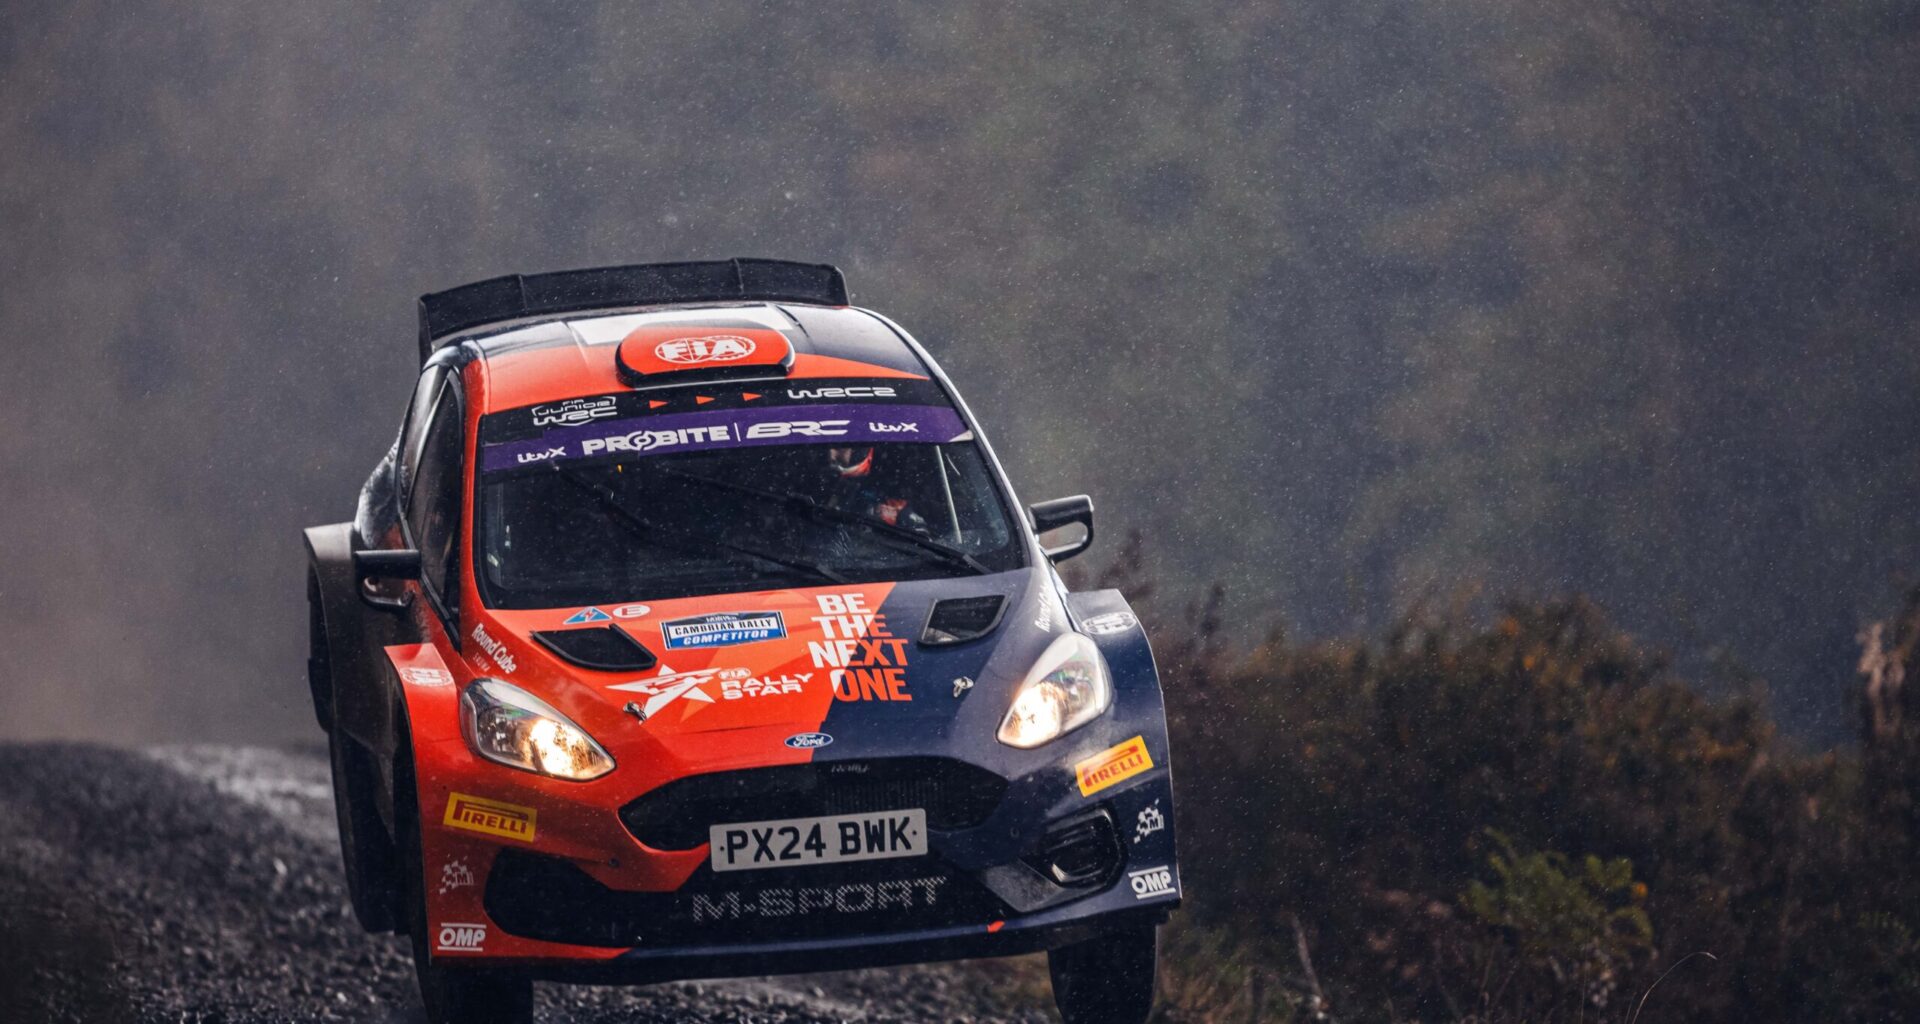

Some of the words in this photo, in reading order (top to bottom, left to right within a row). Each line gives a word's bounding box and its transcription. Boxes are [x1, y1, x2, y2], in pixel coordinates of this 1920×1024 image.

[661, 339, 747, 359] FIA
[787, 387, 896, 398] WRC2
[533, 406, 618, 426] WRC
[581, 424, 730, 456] PROBITE
[746, 420, 851, 439] BRC
[816, 593, 871, 615] BE
[674, 622, 735, 636] CAMBRIAN
[739, 619, 772, 628] RALLY
[811, 614, 893, 639] THE
[471, 622, 501, 656] Round
[492, 641, 518, 675] Cube
[683, 630, 769, 646] COMPETITOR
[807, 638, 909, 668] NEXT
[720, 672, 814, 690] RALLY
[723, 684, 803, 700] STAR
[829, 668, 913, 702] ONE
[792, 734, 825, 747] Ford
[1082, 745, 1144, 788] PIRELLI
[452, 800, 529, 835] PIRELLI
[725, 823, 827, 865] PX24
[837, 816, 913, 856] BWK
[1131, 871, 1172, 894] OMP
[439, 928, 487, 947] OMP
